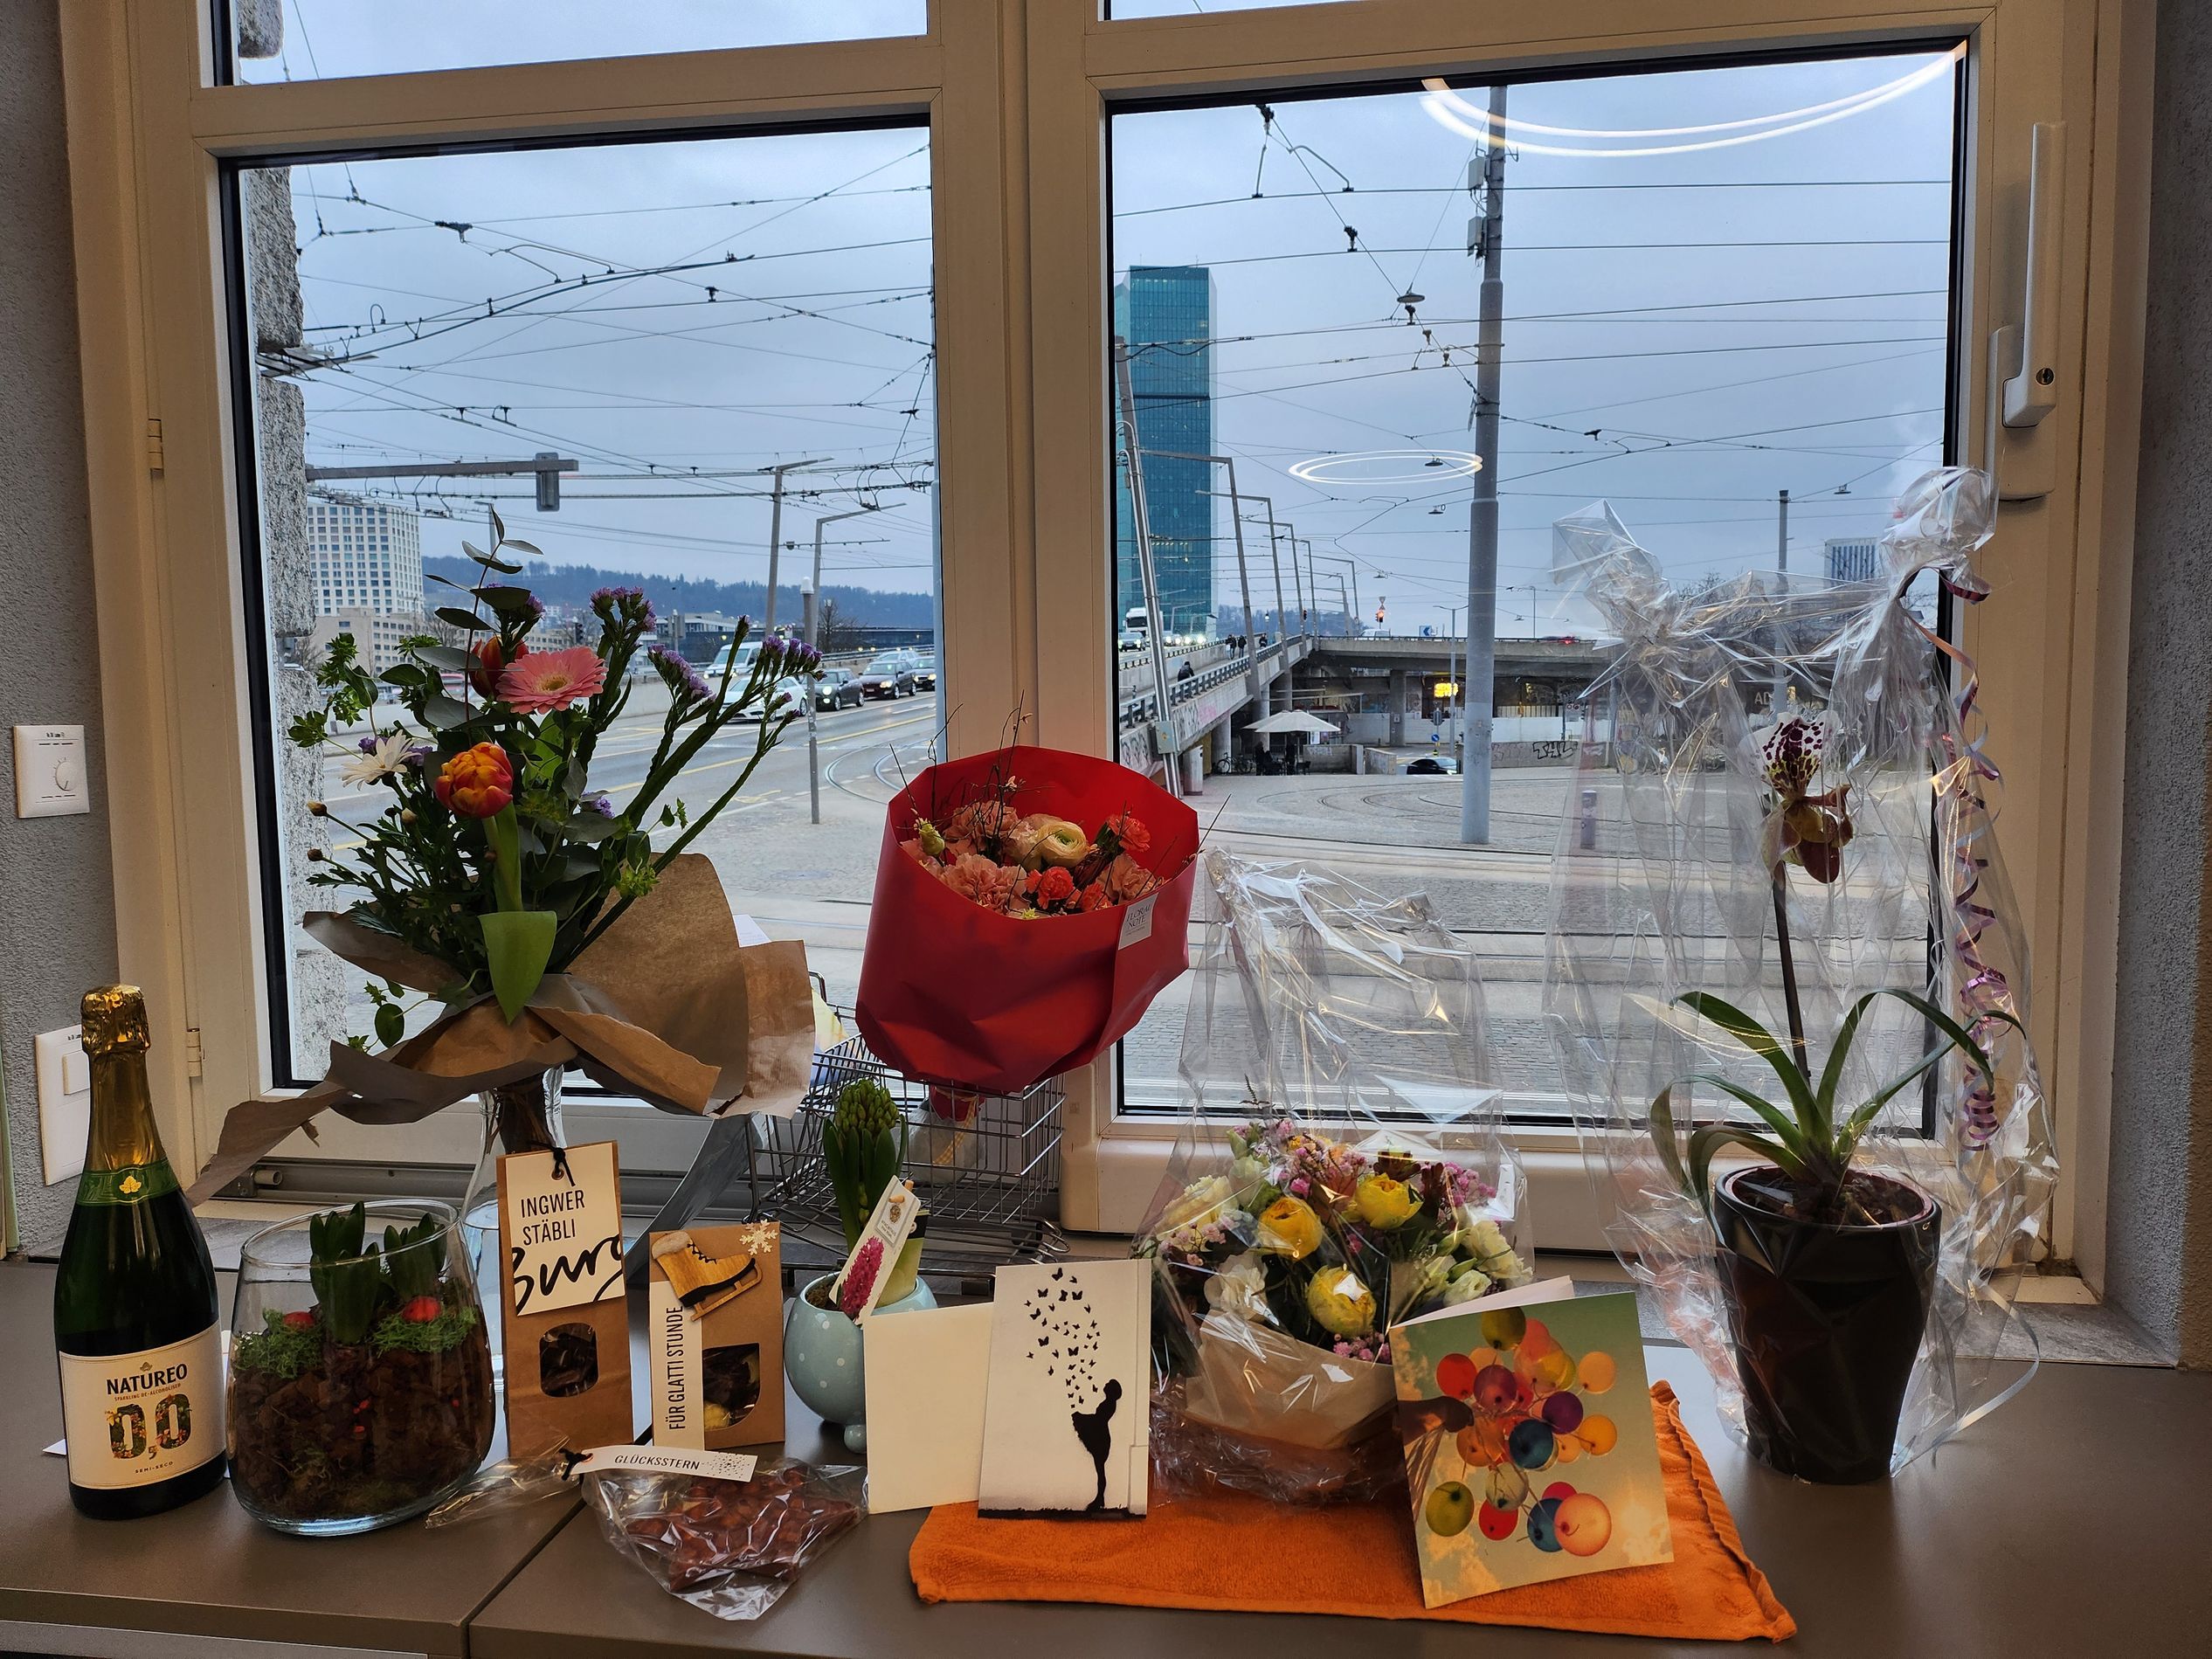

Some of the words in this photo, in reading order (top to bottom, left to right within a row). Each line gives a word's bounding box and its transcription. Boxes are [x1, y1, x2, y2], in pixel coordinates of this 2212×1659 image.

[1127, 915, 1146, 930] NOTE
[521, 1190, 584, 1218] INGWER
[522, 1219, 576, 1246] STÄBLI
[667, 1306, 684, 1357] STUNDE
[107, 1364, 187, 1394] NATUREO
[667, 1360, 685, 1402] GLATTI
[666, 1405, 686, 1429] FÜR
[135, 1461, 174, 1474] SEMI-SECO
[614, 1454, 701, 1470] GLÜCKSSTERN
